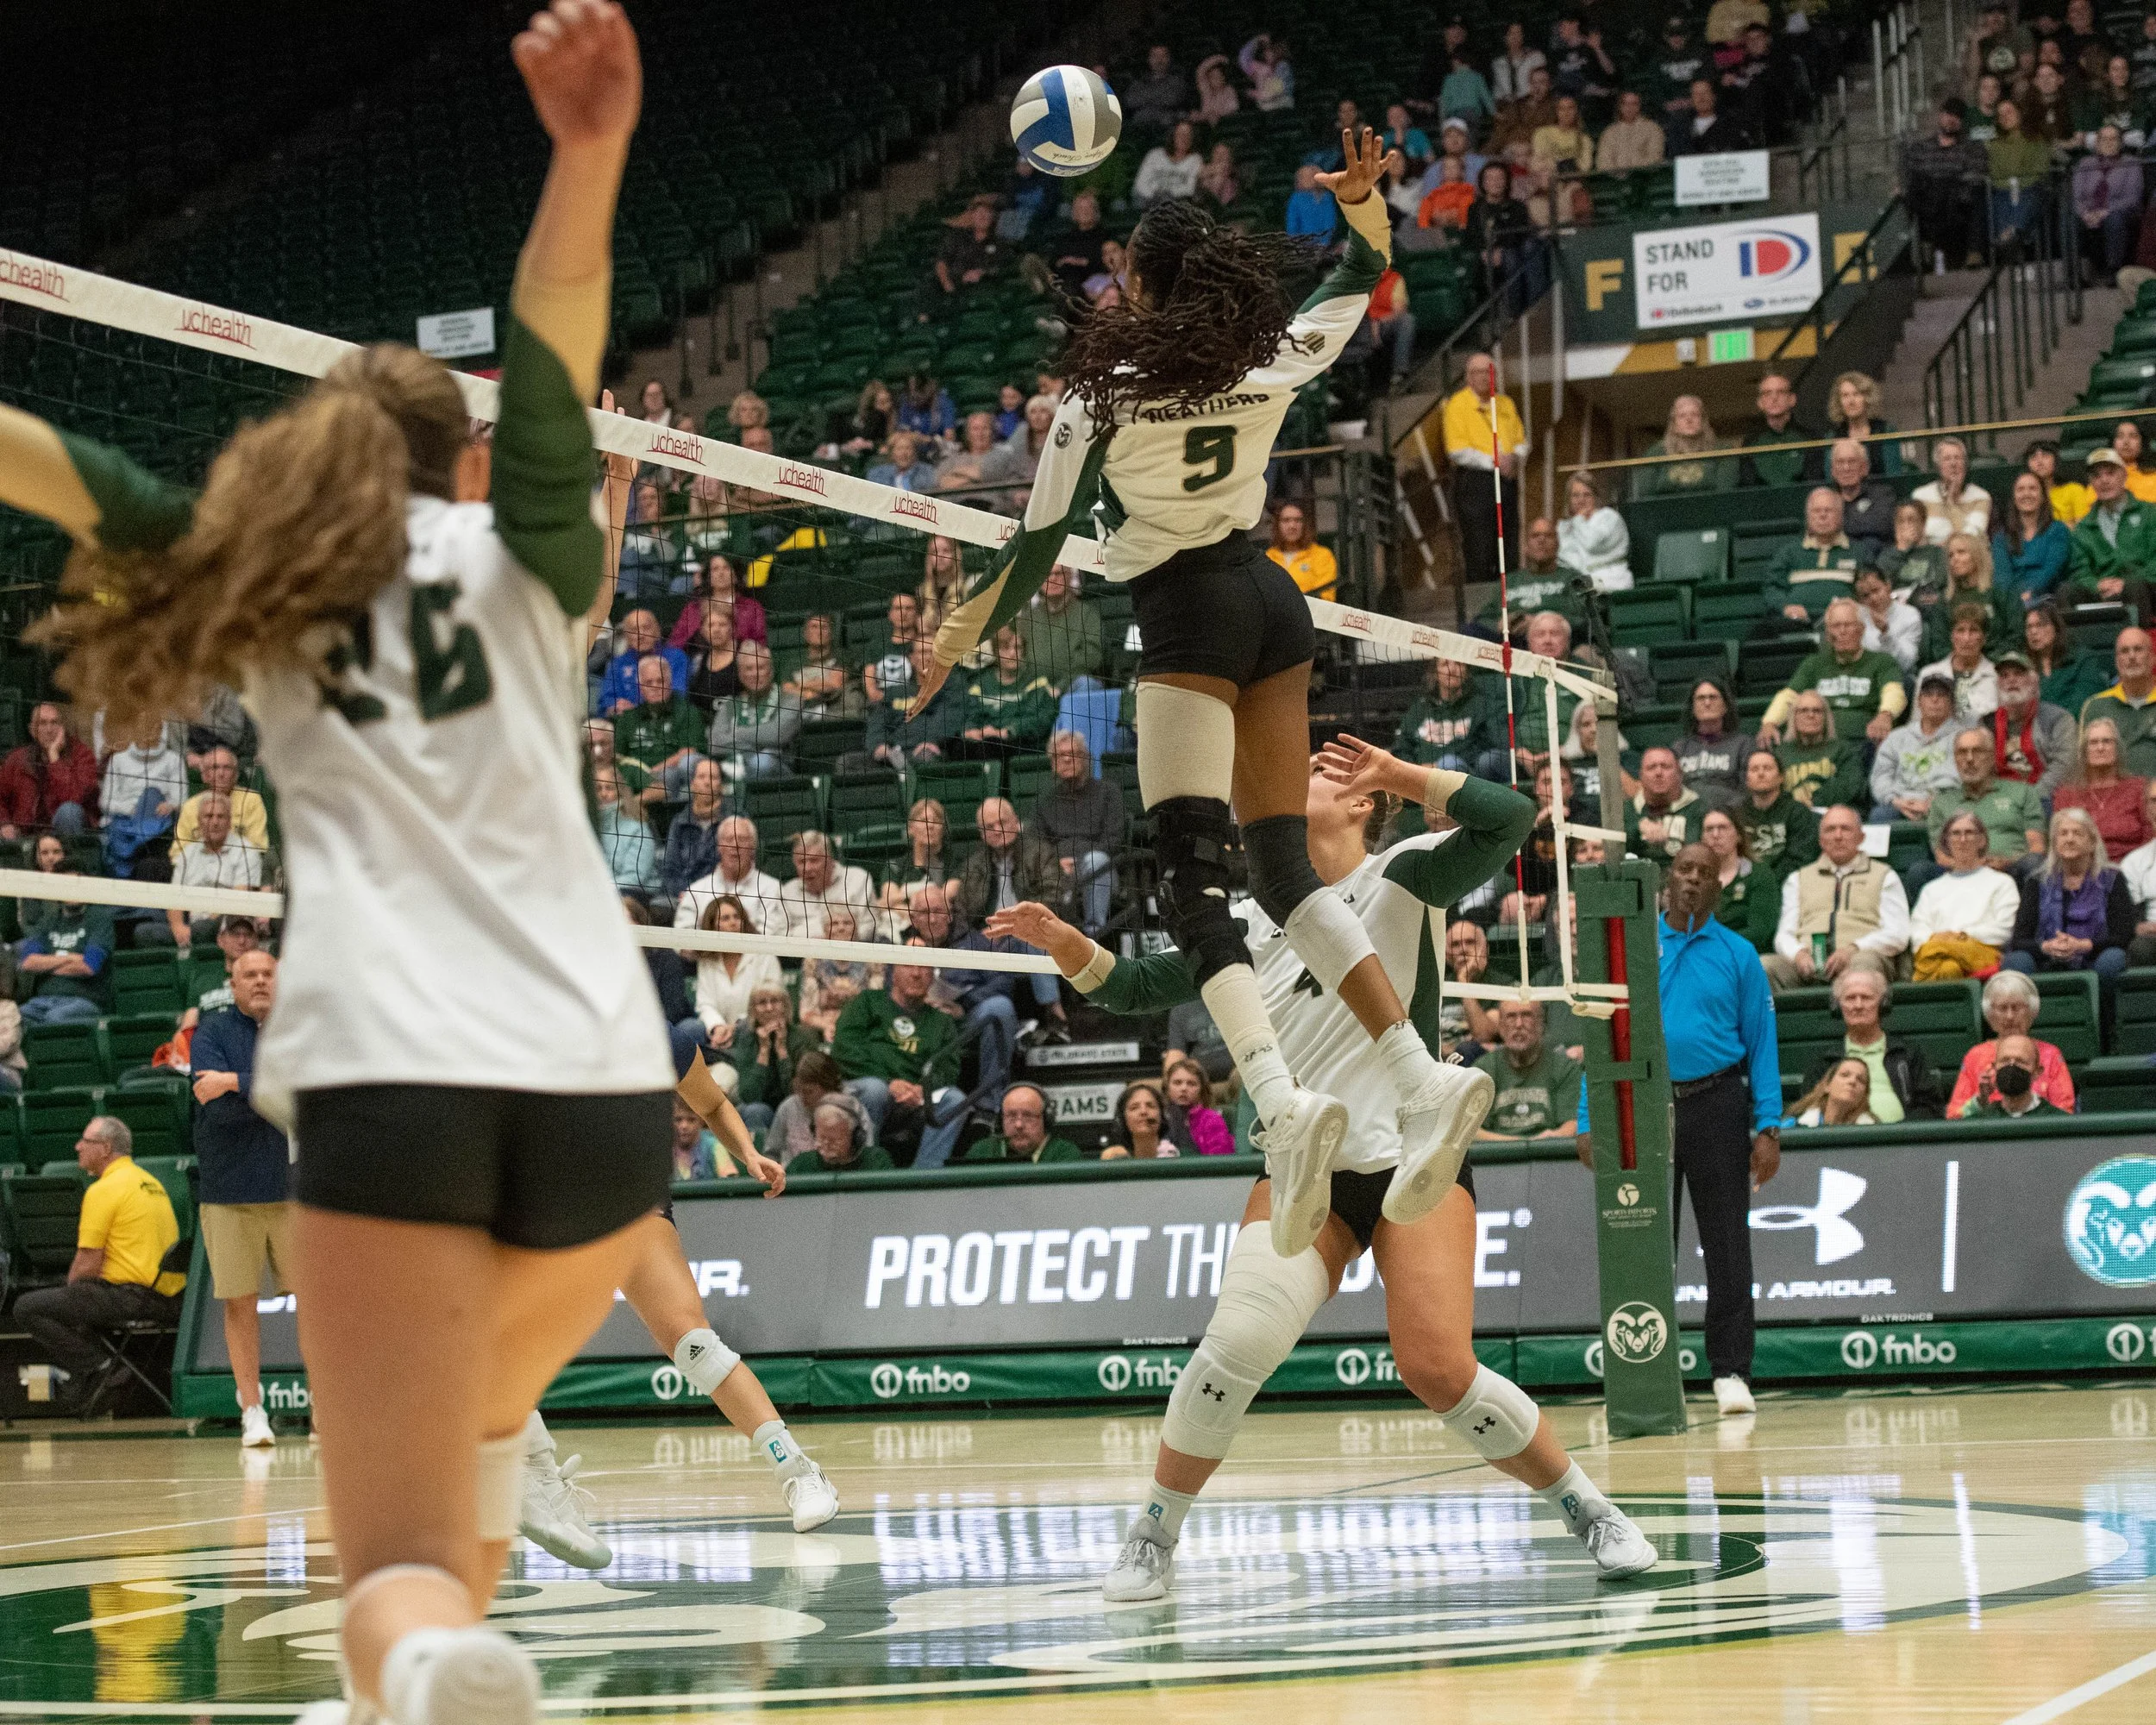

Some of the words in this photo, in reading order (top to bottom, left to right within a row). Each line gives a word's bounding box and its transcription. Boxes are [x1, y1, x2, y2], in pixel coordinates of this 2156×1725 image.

[1645, 239, 1714, 265] STAND
[0, 254, 66, 299] chealth
[1647, 272, 1689, 293] FOR
[180, 304, 253, 347] uchealth
[651, 429, 704, 463] uchealth
[1181, 424, 1238, 492] 9
[779, 461, 824, 494] uchealth
[893, 492, 937, 523] uchealth
[864, 1226, 1151, 1309] PROTECT
[1163, 1222, 1240, 1299] TH
[1861, 1313, 1934, 1323] DAKTRONICS
[690, 1346, 705, 1361] adidas
[1882, 1333, 1957, 1364] fnbo
[905, 1364, 971, 1394] fnbo
[1134, 1357, 1181, 1387] fnb
[267, 1381, 315, 1408] fnb
